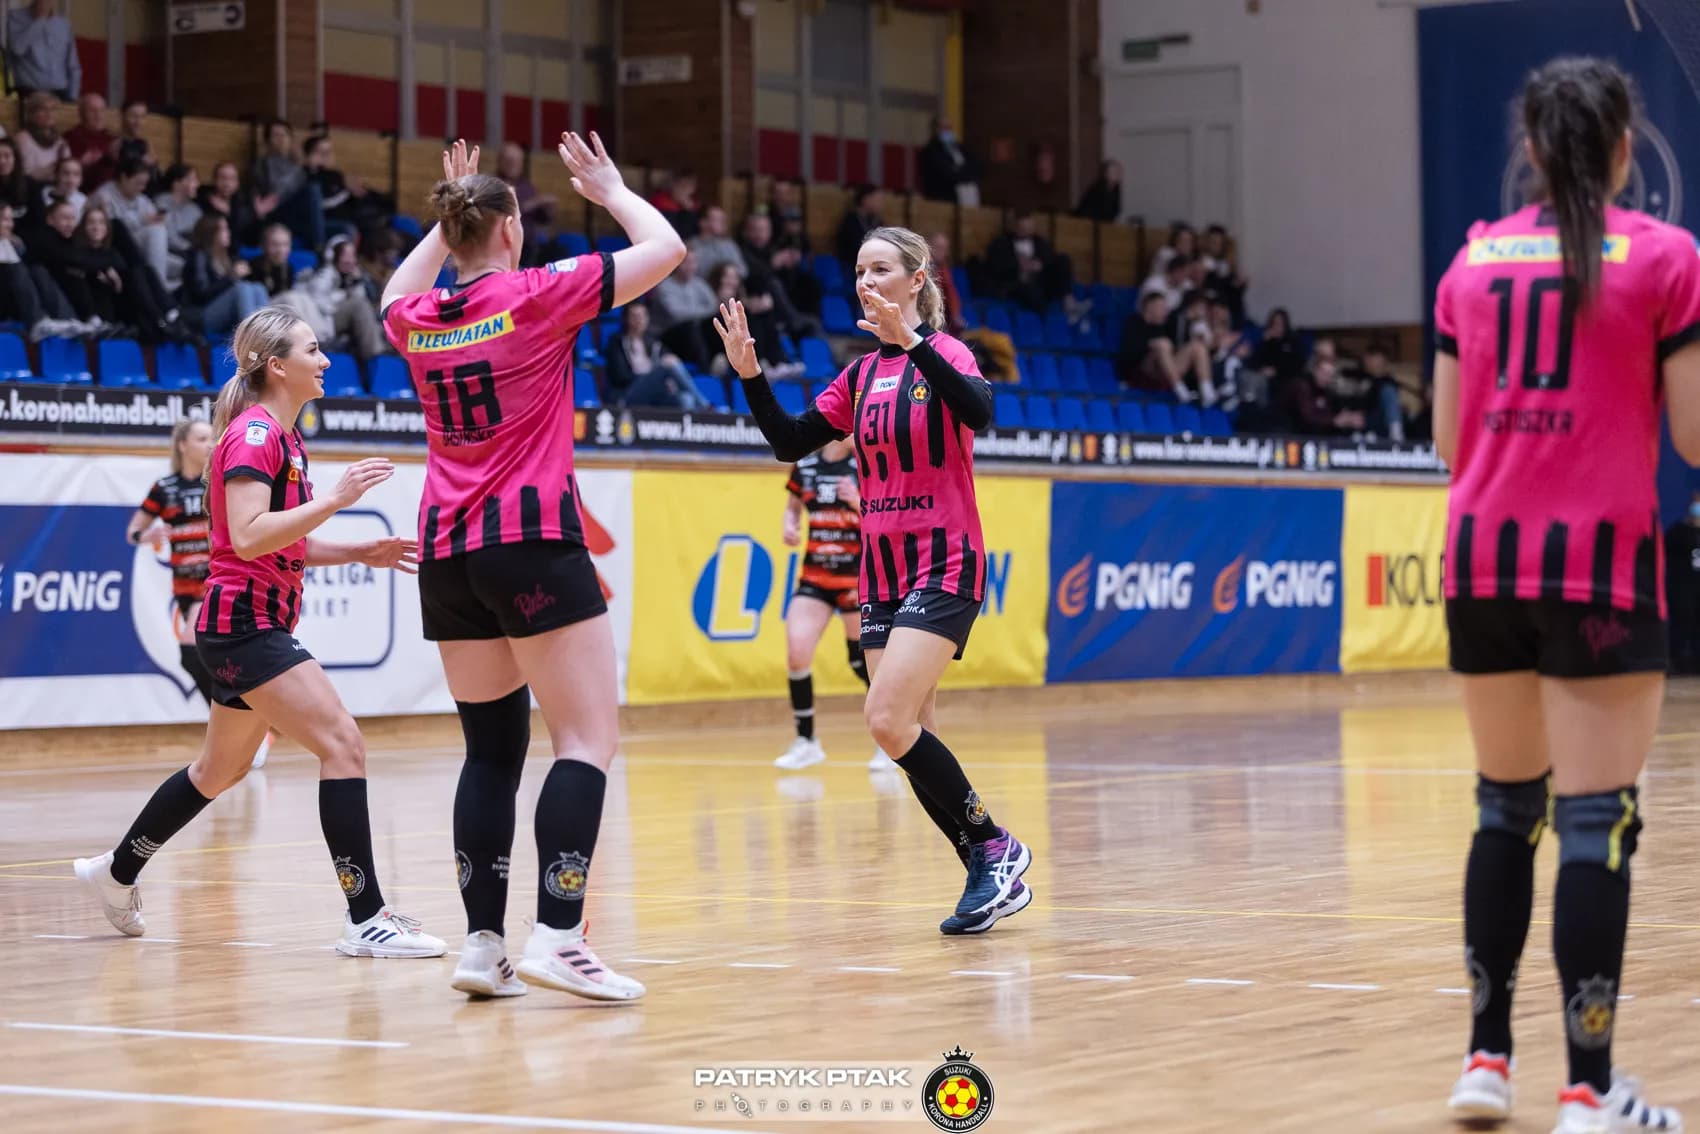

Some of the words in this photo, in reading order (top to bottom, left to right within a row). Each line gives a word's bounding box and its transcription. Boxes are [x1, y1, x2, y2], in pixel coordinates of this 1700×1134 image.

[424, 316, 505, 349] LEWIATAN
[1488, 276, 1577, 390] 10
[426, 360, 503, 433] 18
[864, 401, 891, 447] 31
[870, 495, 934, 514] SUZUKI
[12, 570, 123, 612] PGNiG
[1095, 561, 1195, 611] PGNiG
[1246, 559, 1337, 608] PGNiG
